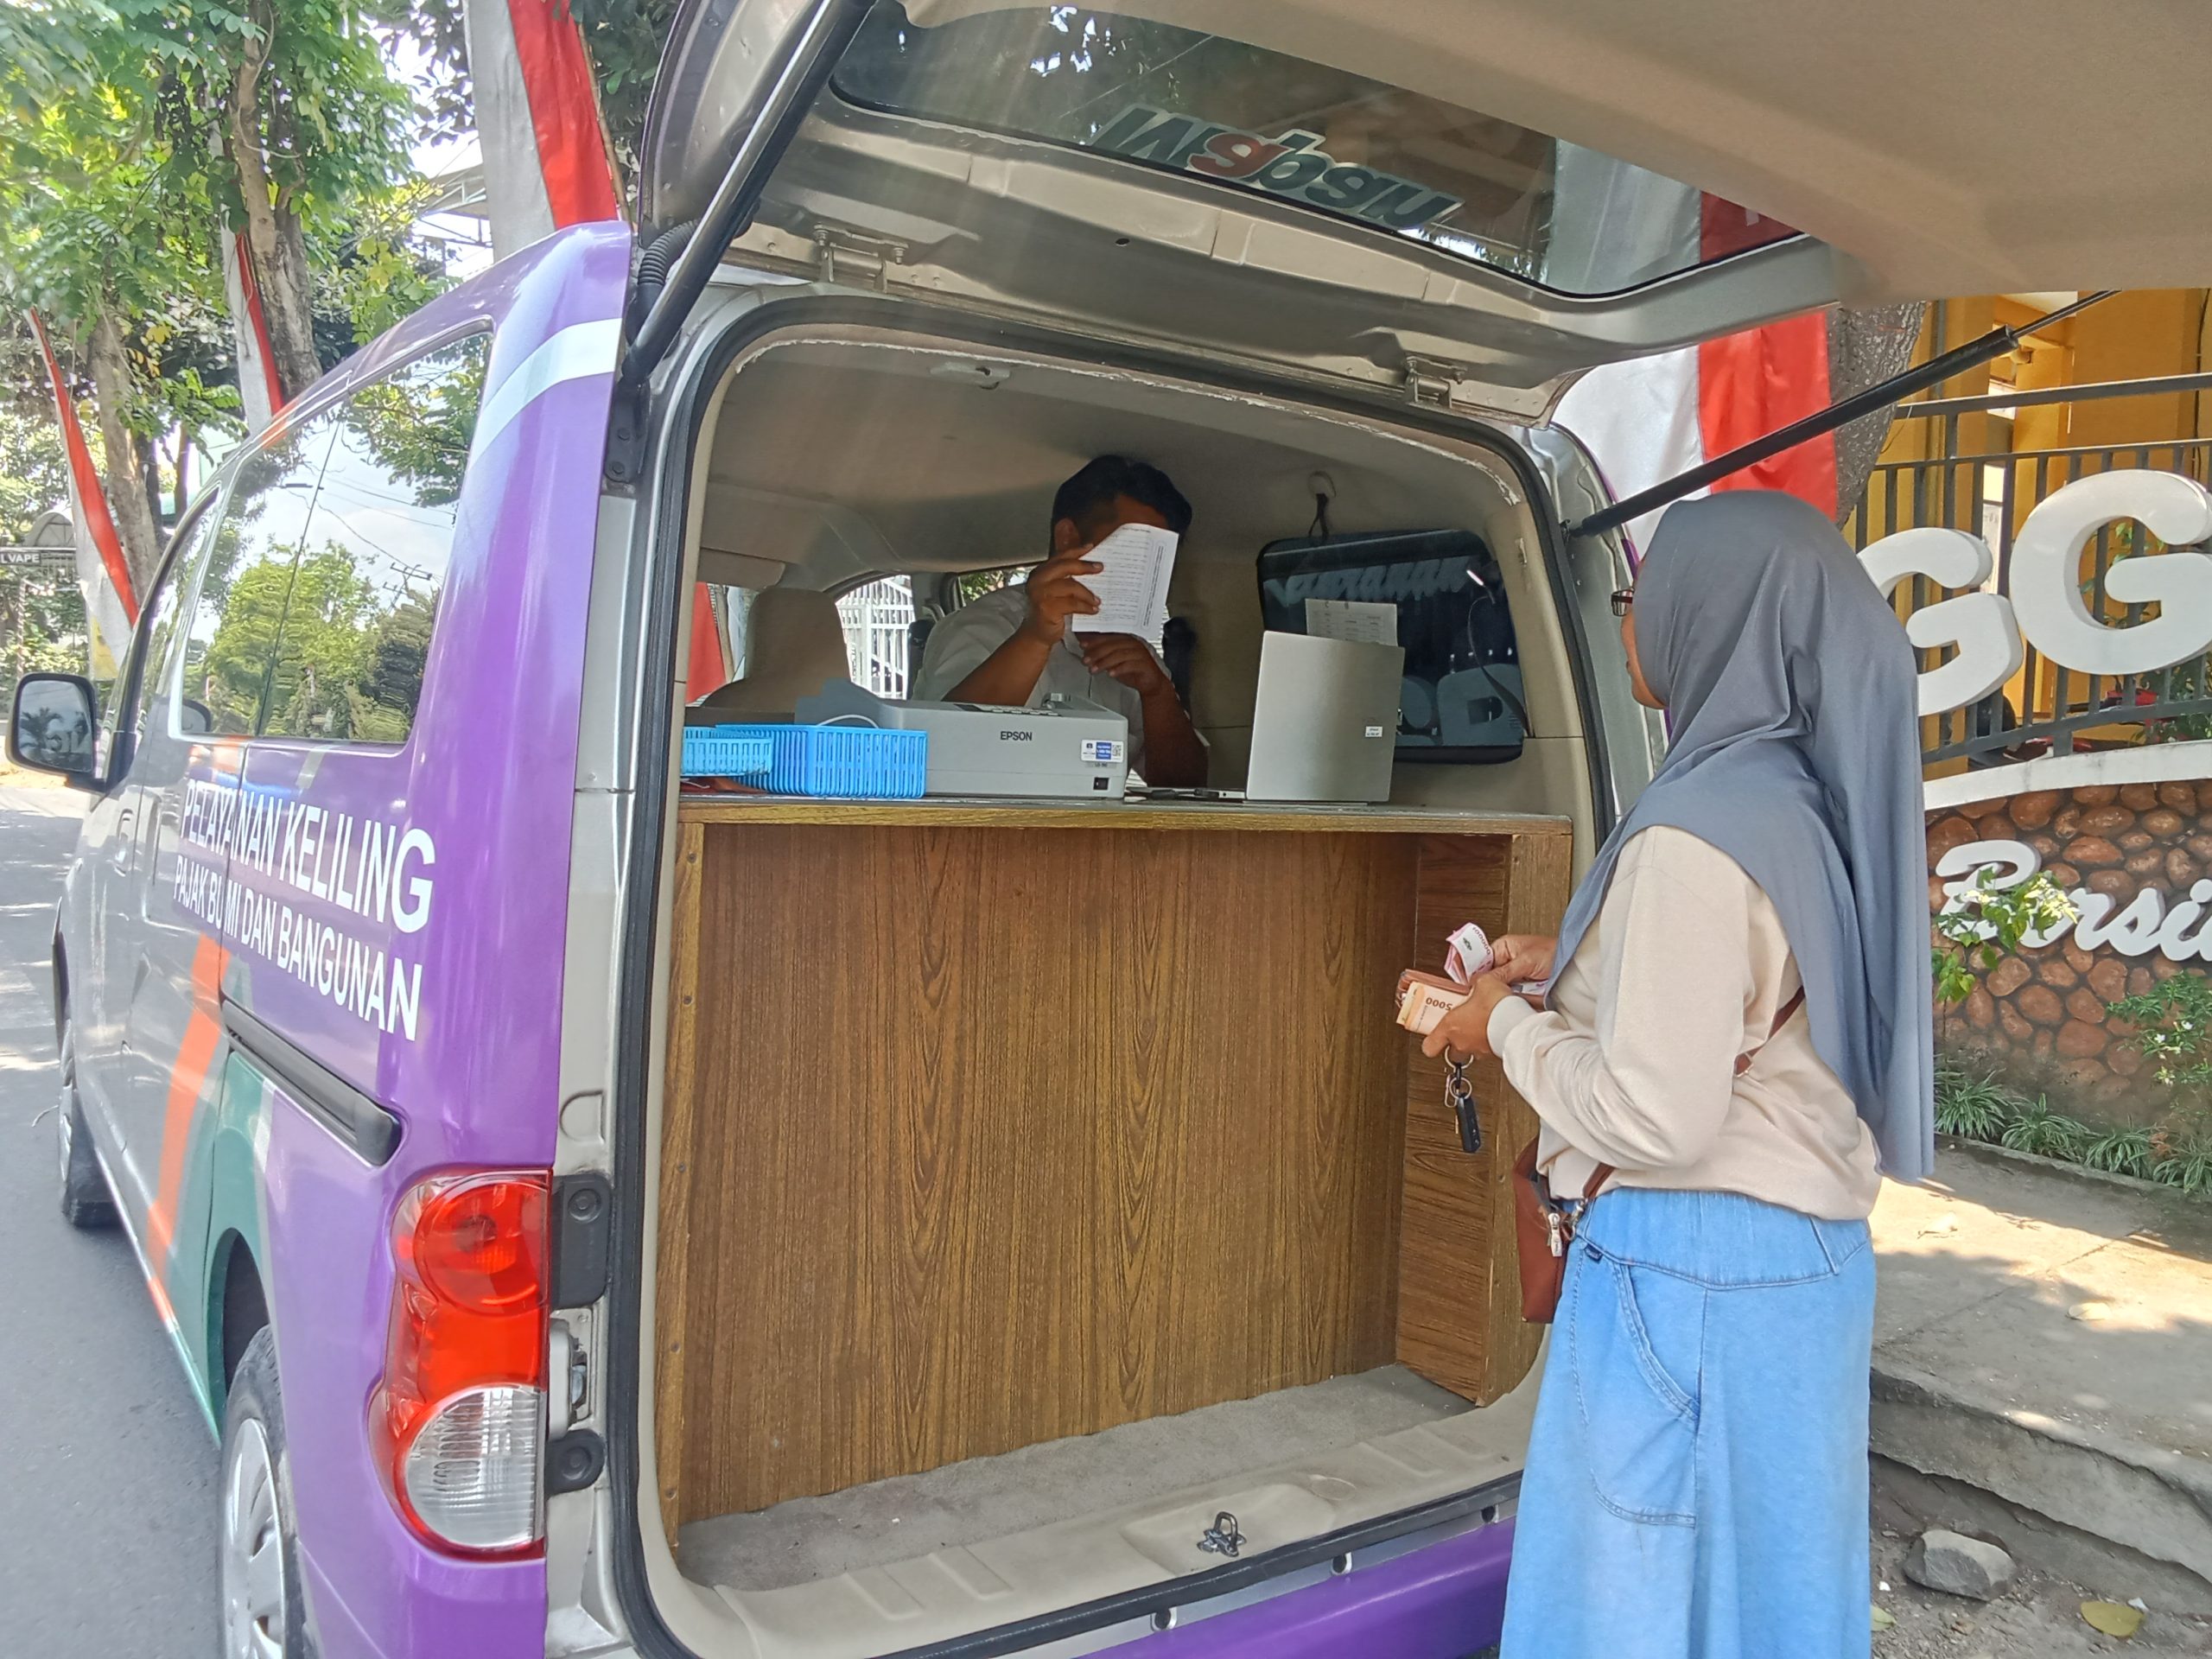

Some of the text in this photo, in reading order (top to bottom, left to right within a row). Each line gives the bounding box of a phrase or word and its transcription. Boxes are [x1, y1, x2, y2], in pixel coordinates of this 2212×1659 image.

[9, 553, 40, 563] VAPE
[1000, 731, 1033, 741] EPSON
[180, 779, 435, 933] PELAYANAN KELILING
[173, 855, 423, 1042] PAJAK BUMI DAN BANGUNAN
[1425, 996, 1452, 1011] 5000
